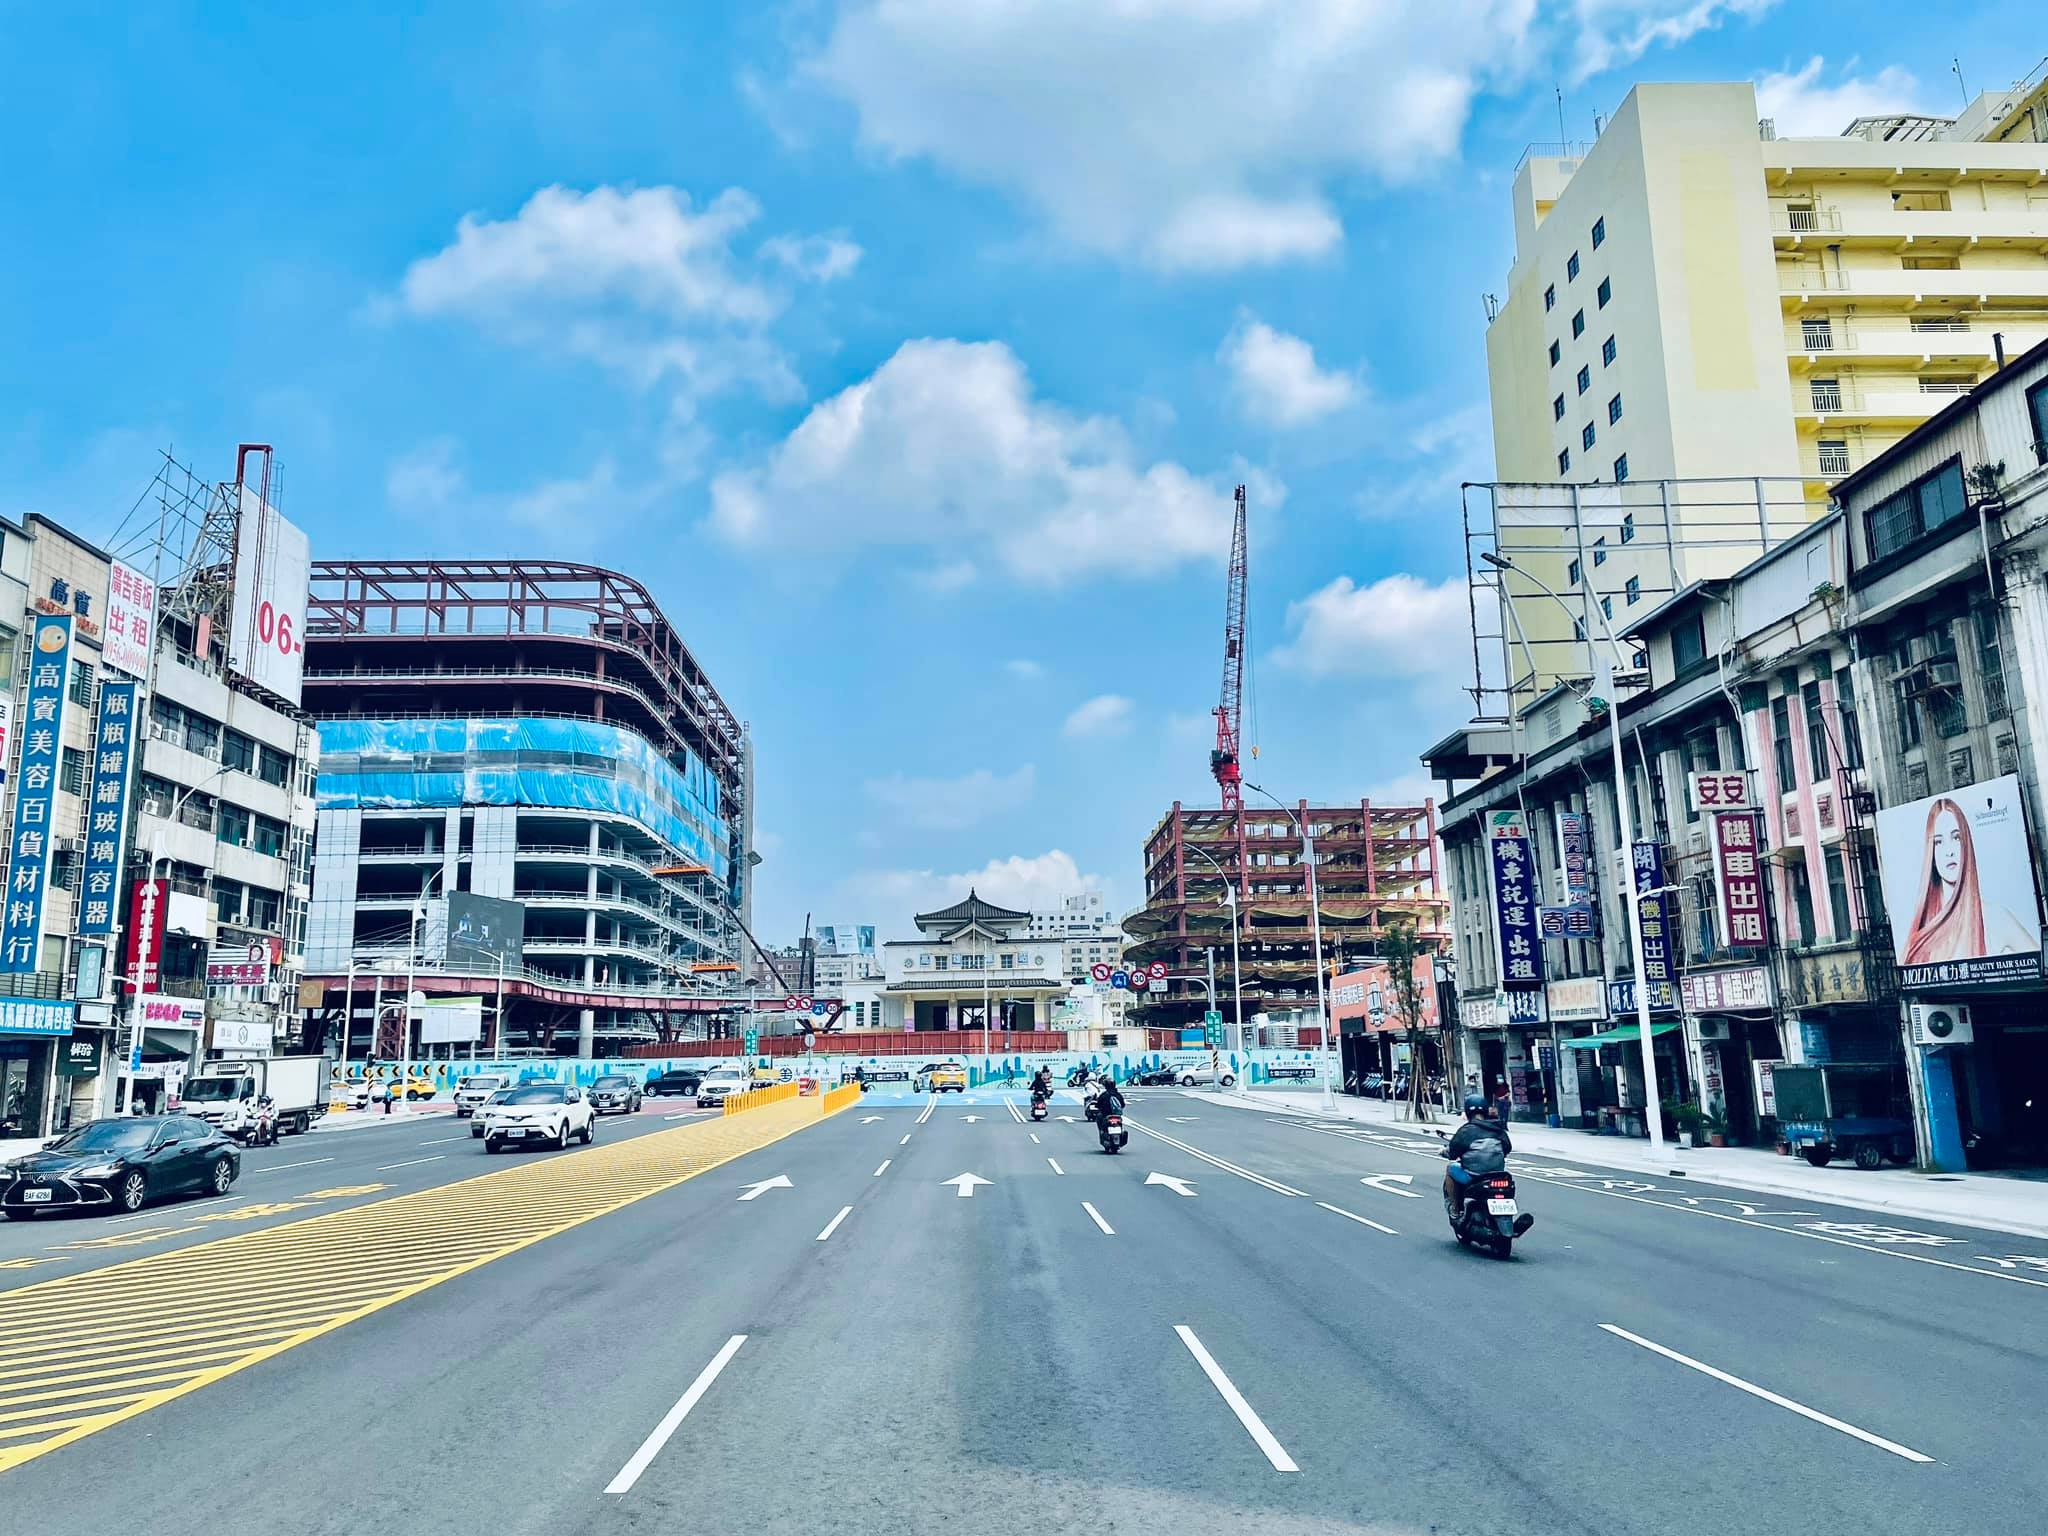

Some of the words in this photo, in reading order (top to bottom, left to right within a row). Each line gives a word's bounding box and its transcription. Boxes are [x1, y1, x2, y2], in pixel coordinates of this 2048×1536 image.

[112, 565, 153, 612] 廣告看板
[109, 605, 148, 647] 出租
[6, 663, 61, 963] 高賓美容百貨材料行
[86, 692, 128, 923] 瓶瓶罐罐玻璃容器
[1697, 775, 1745, 805] 安安
[1563, 818, 1585, 887] 室內寄車
[1721, 819, 1763, 941] 機車出租
[1543, 910, 1591, 934] 寄車
[1633, 844, 1668, 979] 開元機車出租
[1135, 975, 1144, 983] 30
[1970, 963, 1994, 972] BEAUTY
[1996, 960, 2014, 969] HAIR
[2015, 958, 2038, 967] SALON
